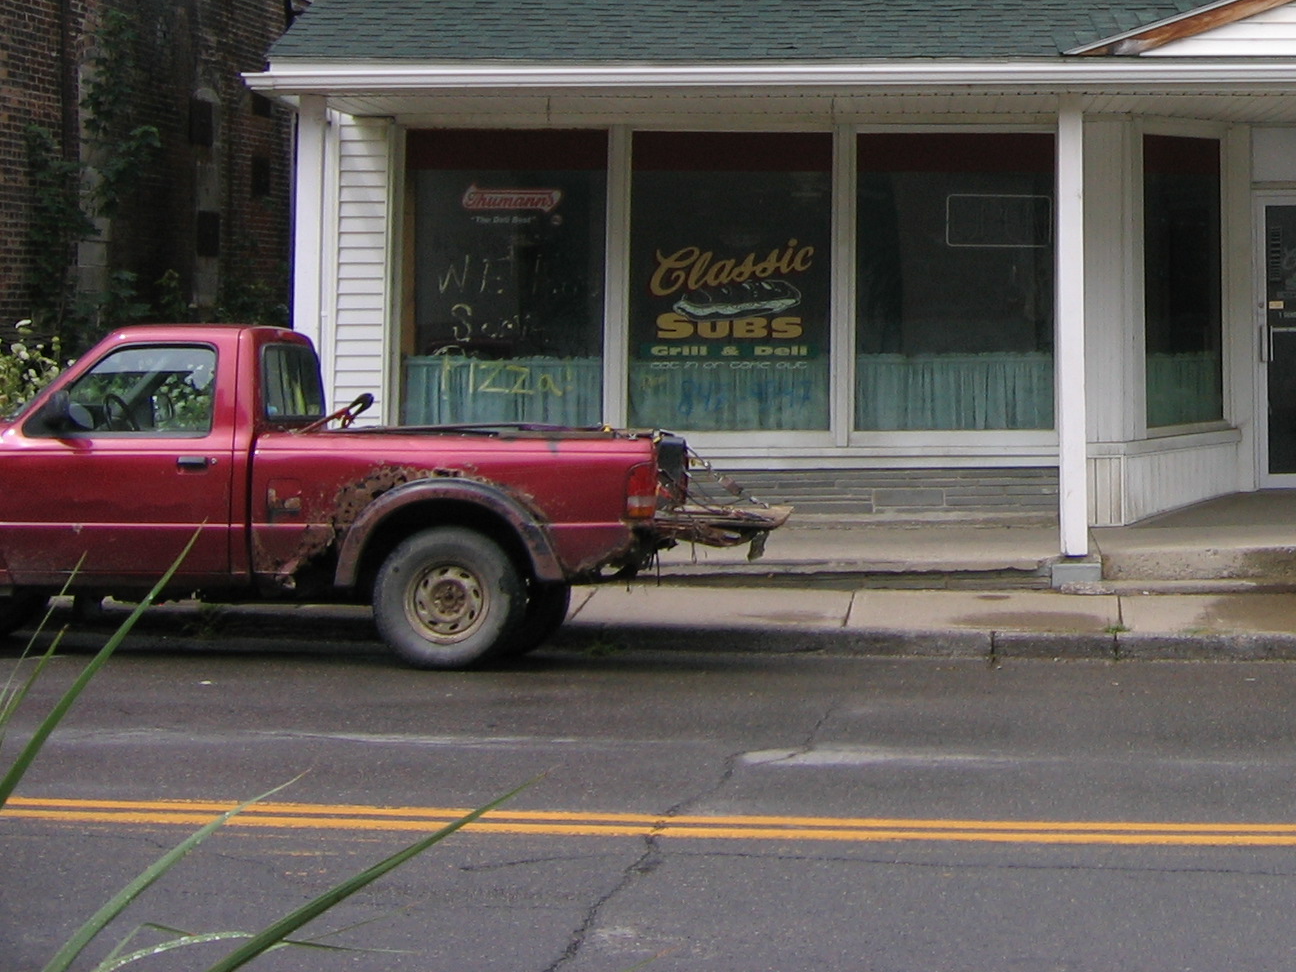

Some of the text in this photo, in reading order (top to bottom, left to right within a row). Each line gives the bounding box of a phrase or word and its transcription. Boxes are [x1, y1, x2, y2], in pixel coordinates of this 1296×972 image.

[650, 238, 815, 297] Classic
[656, 312, 803, 339] SUBS
[651, 345, 808, 357] Grill & Deli
[703, 361, 724, 370] or
